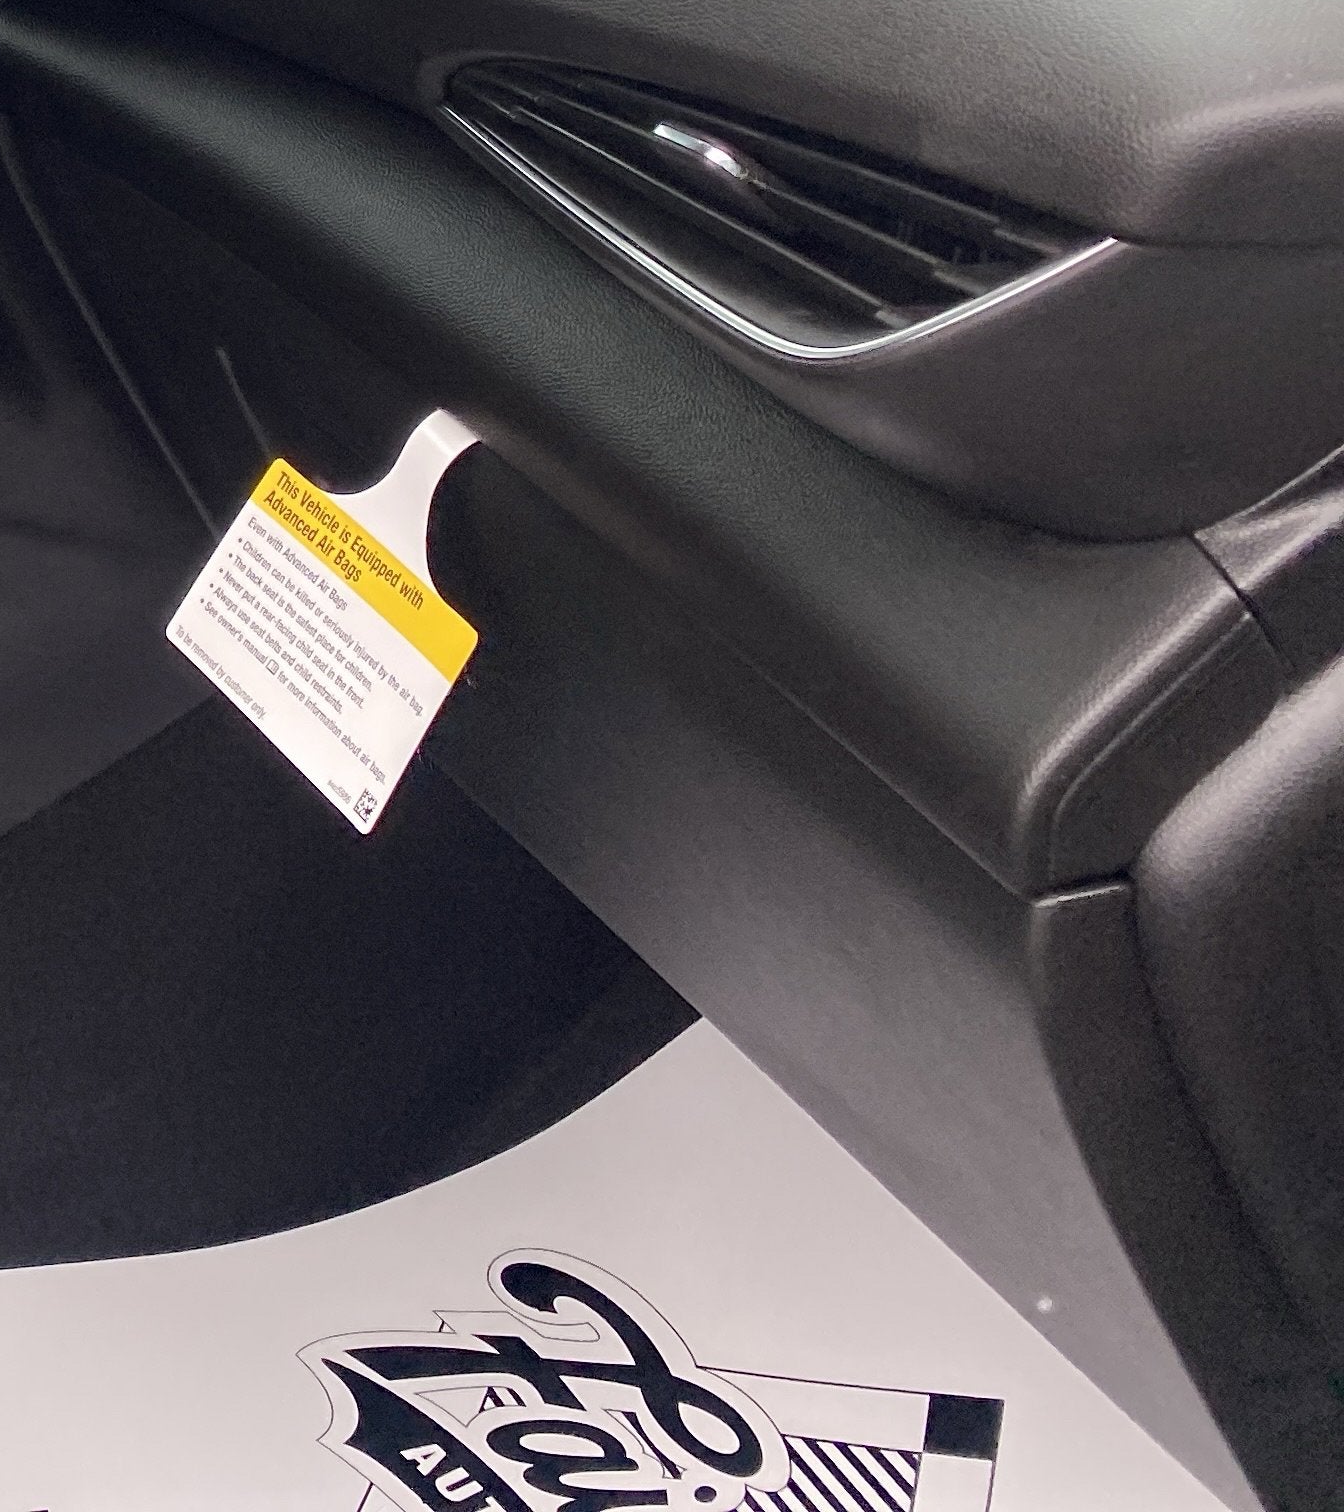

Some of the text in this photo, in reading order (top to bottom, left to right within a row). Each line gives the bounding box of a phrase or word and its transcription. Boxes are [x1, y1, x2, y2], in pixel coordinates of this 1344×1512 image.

[247, 516, 348, 612] Even with Advanced Air Bags
[262, 488, 363, 584] Advanced Air Bags
[275, 470, 425, 610] This Vehicle is Equipped with
[212, 585, 238, 614] Always
[236, 608, 250, 624] use
[249, 620, 266, 639] seat
[264, 632, 282, 654] belts
[280, 649, 296, 666] and
[293, 661, 312, 682] child
[222, 570, 244, 594] Never
[240, 589, 256, 606] put
[253, 600, 260, 610] a
[258, 604, 297, 644] rear-facing
[295, 638, 314, 658] child
[311, 653, 328, 673] seat
[326, 666, 336, 680] in
[334, 674, 347, 691] the
[232, 554, 247, 572] The
[245, 566, 263, 588] back
[261, 582, 279, 602] seat
[276, 595, 285, 607] is
[283, 602, 297, 618] the
[295, 613, 318, 637] safest
[314, 632, 335, 655] place
[333, 648, 346, 664] for
[242, 540, 272, 571] Children
[270, 567, 285, 584] can
[284, 577, 296, 592] be
[294, 586, 316, 610] killed
[313, 606, 324, 618] or
[321, 613, 354, 648] seriously
[352, 640, 379, 671] injured
[376, 664, 389, 681] by
[387, 674, 400, 691] the
[398, 686, 411, 701] air
